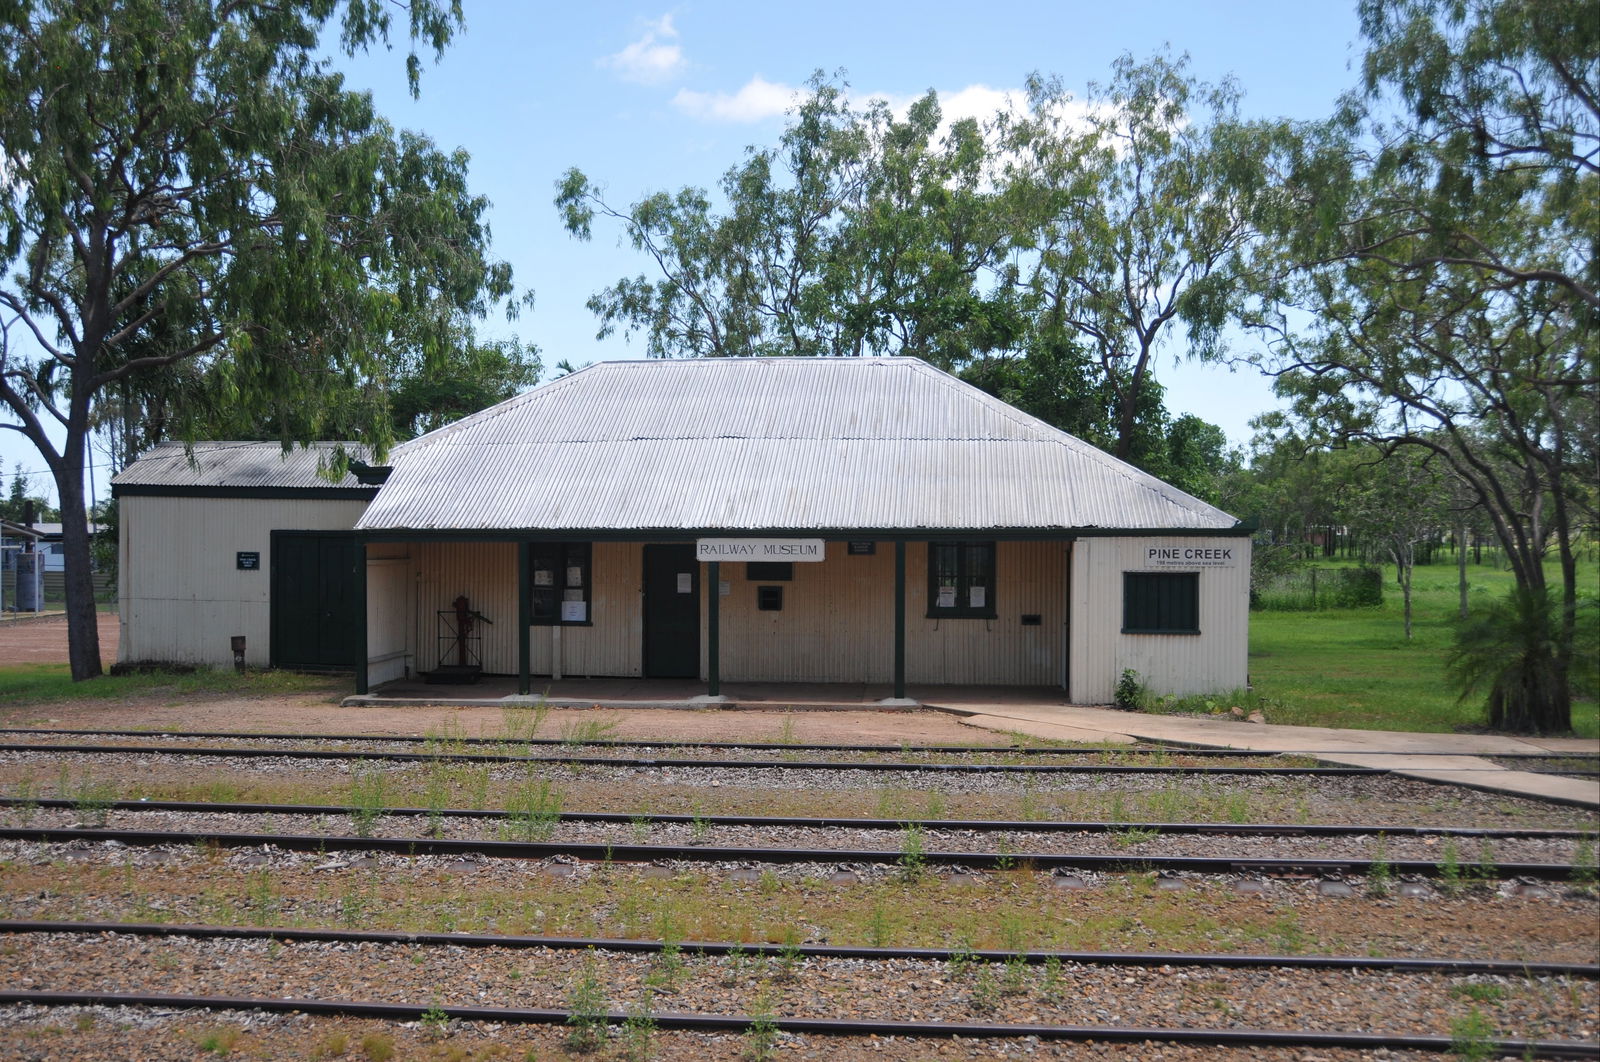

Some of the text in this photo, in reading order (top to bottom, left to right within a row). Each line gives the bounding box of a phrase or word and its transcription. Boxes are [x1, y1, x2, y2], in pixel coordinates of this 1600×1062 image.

[700, 544, 817, 555] RAILWAY MUSEUM
[1149, 549, 1232, 559] PINE CREEK
